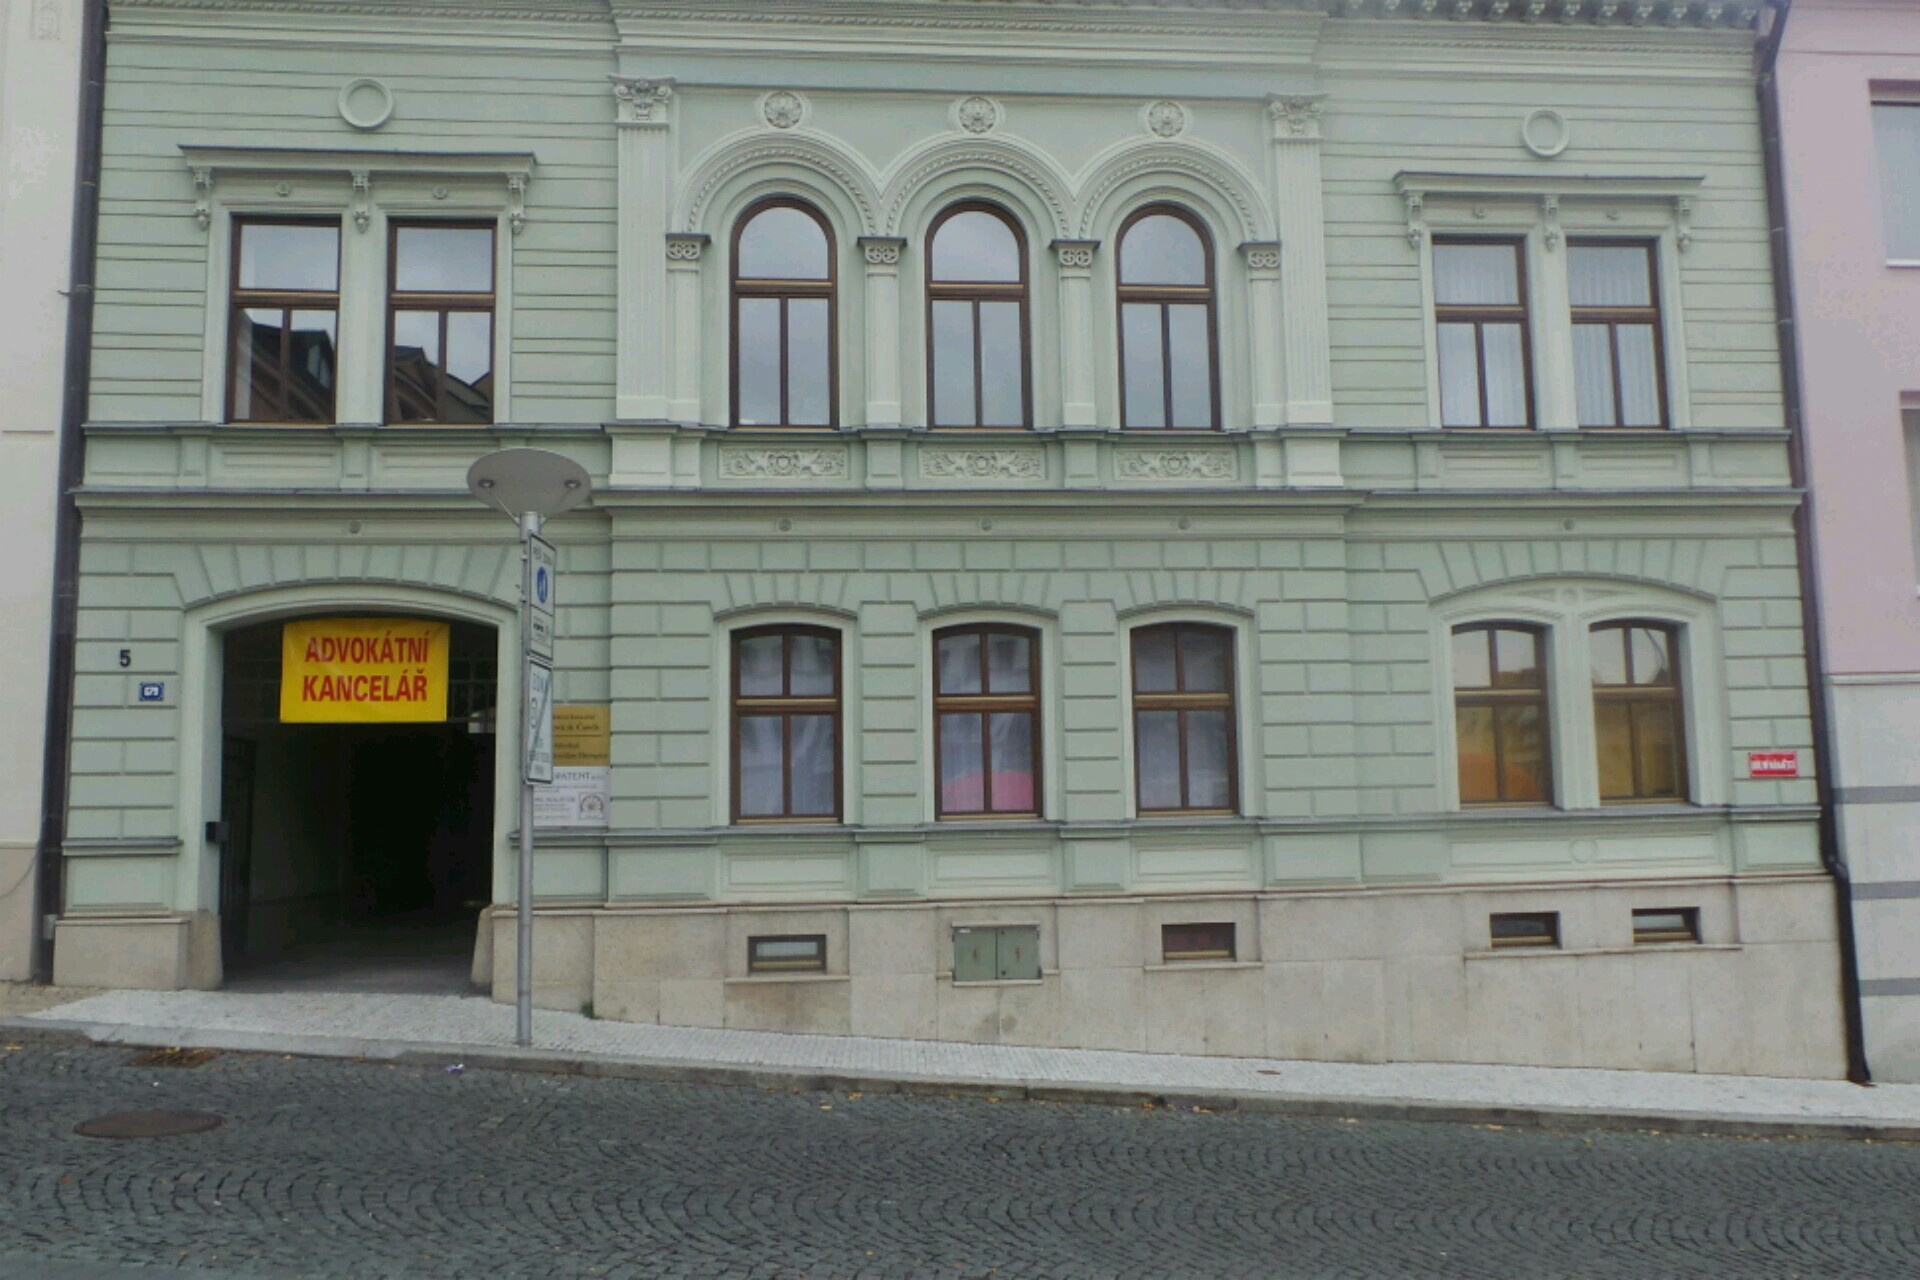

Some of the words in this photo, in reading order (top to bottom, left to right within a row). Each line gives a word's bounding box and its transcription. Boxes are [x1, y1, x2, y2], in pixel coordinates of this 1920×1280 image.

[119, 649, 131, 668] 5
[305, 630, 430, 663] ADVOKÁTNÍ
[302, 669, 428, 702] KANCELÁŘ
